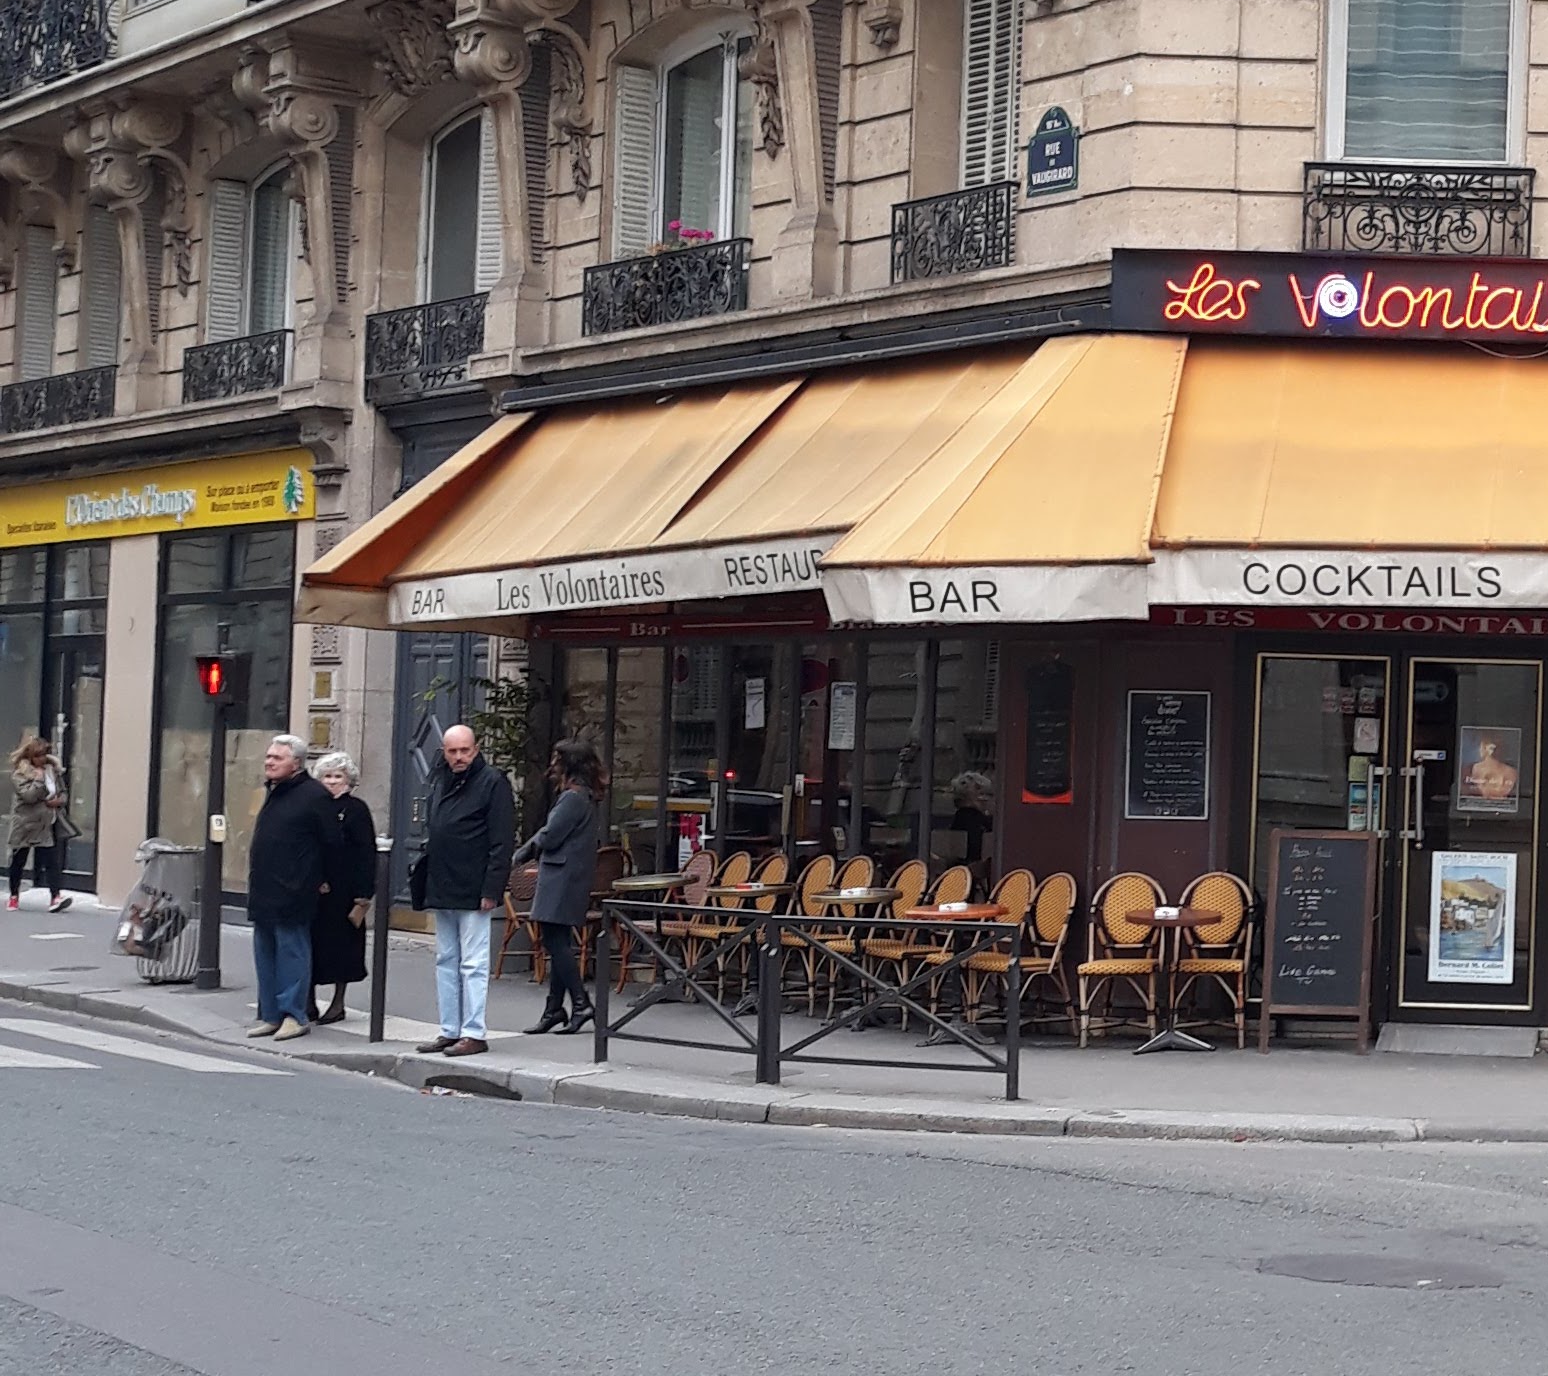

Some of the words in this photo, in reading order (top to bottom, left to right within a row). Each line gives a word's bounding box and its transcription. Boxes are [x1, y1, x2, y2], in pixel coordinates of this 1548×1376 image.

[1164, 262, 1260, 321] Les
[411, 587, 446, 615] BAR
[496, 577, 531, 611] Les
[539, 562, 665, 606] Volontaires
[909, 580, 1002, 613] BAR
[1242, 562, 1503, 598] COCKTAILS
[630, 623, 670, 636] Bar
[1173, 609, 1256, 627] LES
